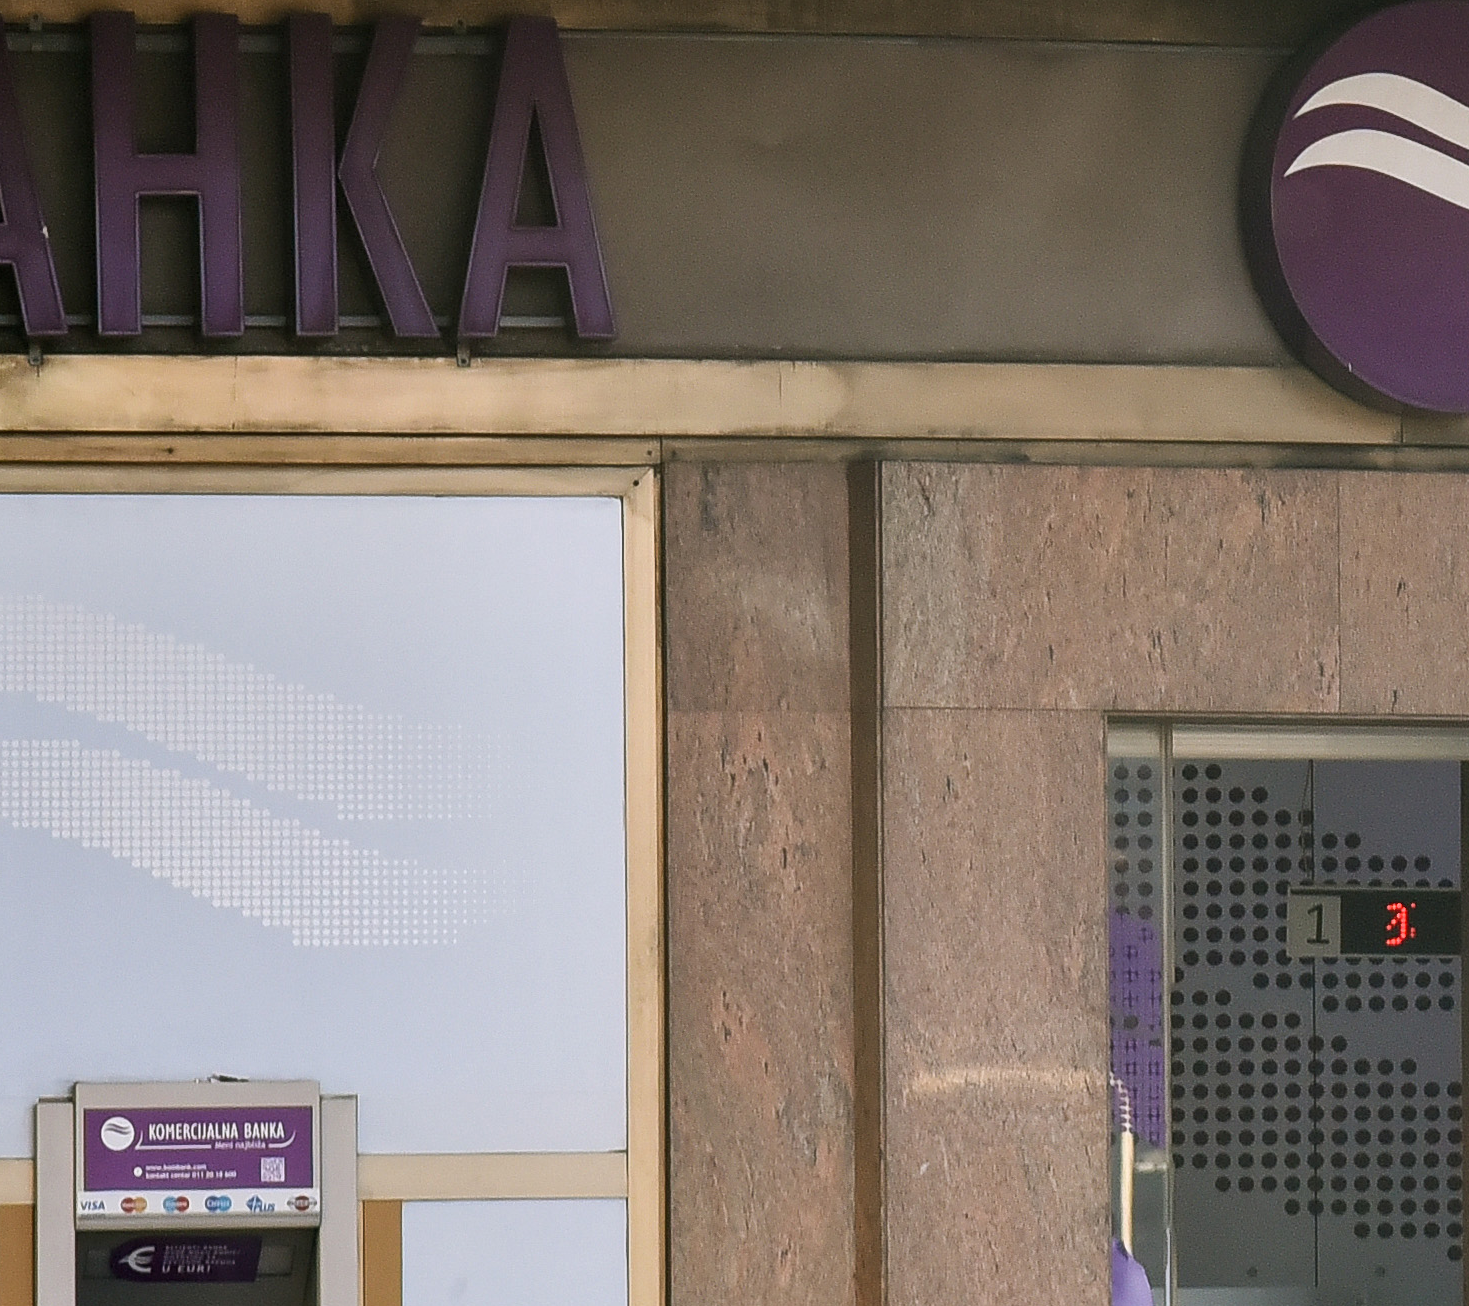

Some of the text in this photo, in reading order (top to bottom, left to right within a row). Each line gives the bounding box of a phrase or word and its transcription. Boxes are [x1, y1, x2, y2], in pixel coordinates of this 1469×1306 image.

[1306, 902, 1330, 945] 1
[148, 1121, 286, 1141] KOMERCIJALNA BANKA
[80, 1200, 106, 1211] VISA
